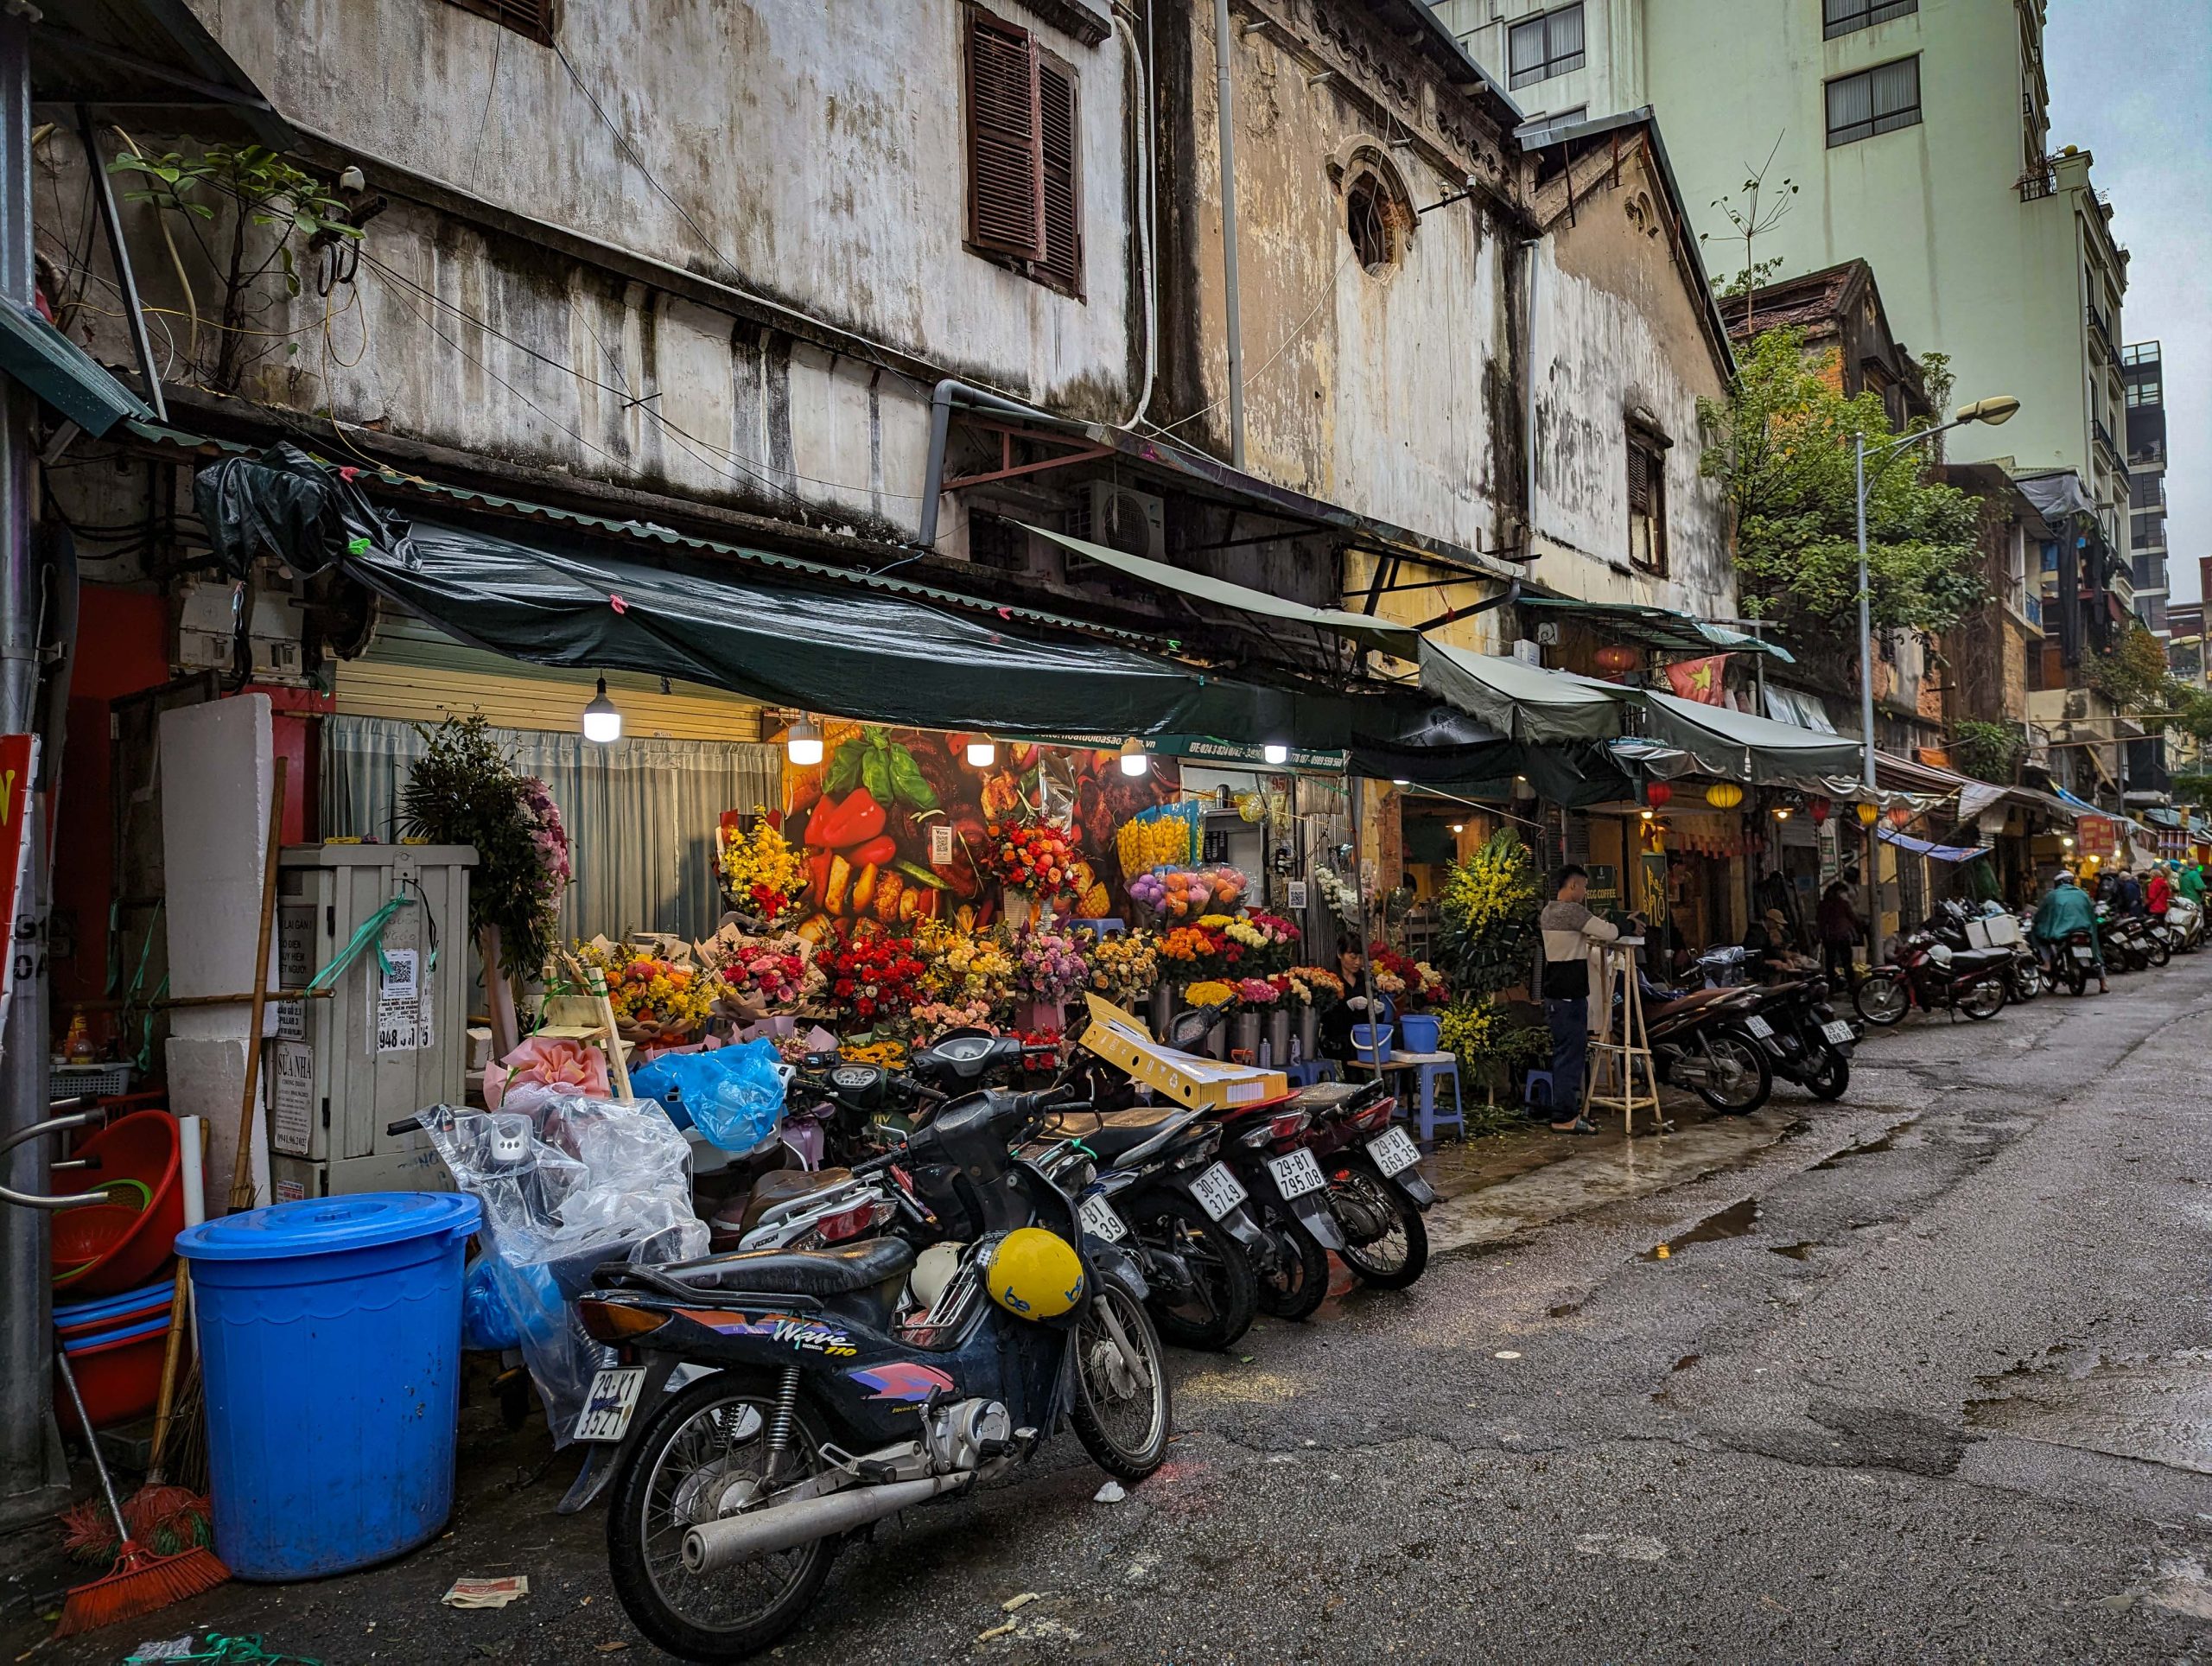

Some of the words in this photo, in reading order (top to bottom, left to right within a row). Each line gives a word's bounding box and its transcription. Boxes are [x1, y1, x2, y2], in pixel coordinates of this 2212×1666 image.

[1271, 778, 1285, 792] 95
[1586, 888, 1598, 899] EGG
[1597, 888, 1617, 899] COFFEE
[1374, 1131, 1406, 1158] 29-B1
[1276, 1153, 1310, 1178] 29-B1
[1381, 1145, 1418, 1175] 369.35
[1196, 1167, 1229, 1199] 30-F1
[1281, 1168, 1322, 1197] 795.08
[1209, 1184, 1241, 1215] 3749
[752, 1232, 779, 1250] VISION
[1004, 1285, 1031, 1313] be
[1065, 1275, 1084, 1303] be
[773, 1319, 855, 1346] Wave
[802, 1343, 823, 1351] HONDA
[824, 1345, 857, 1357] 110
